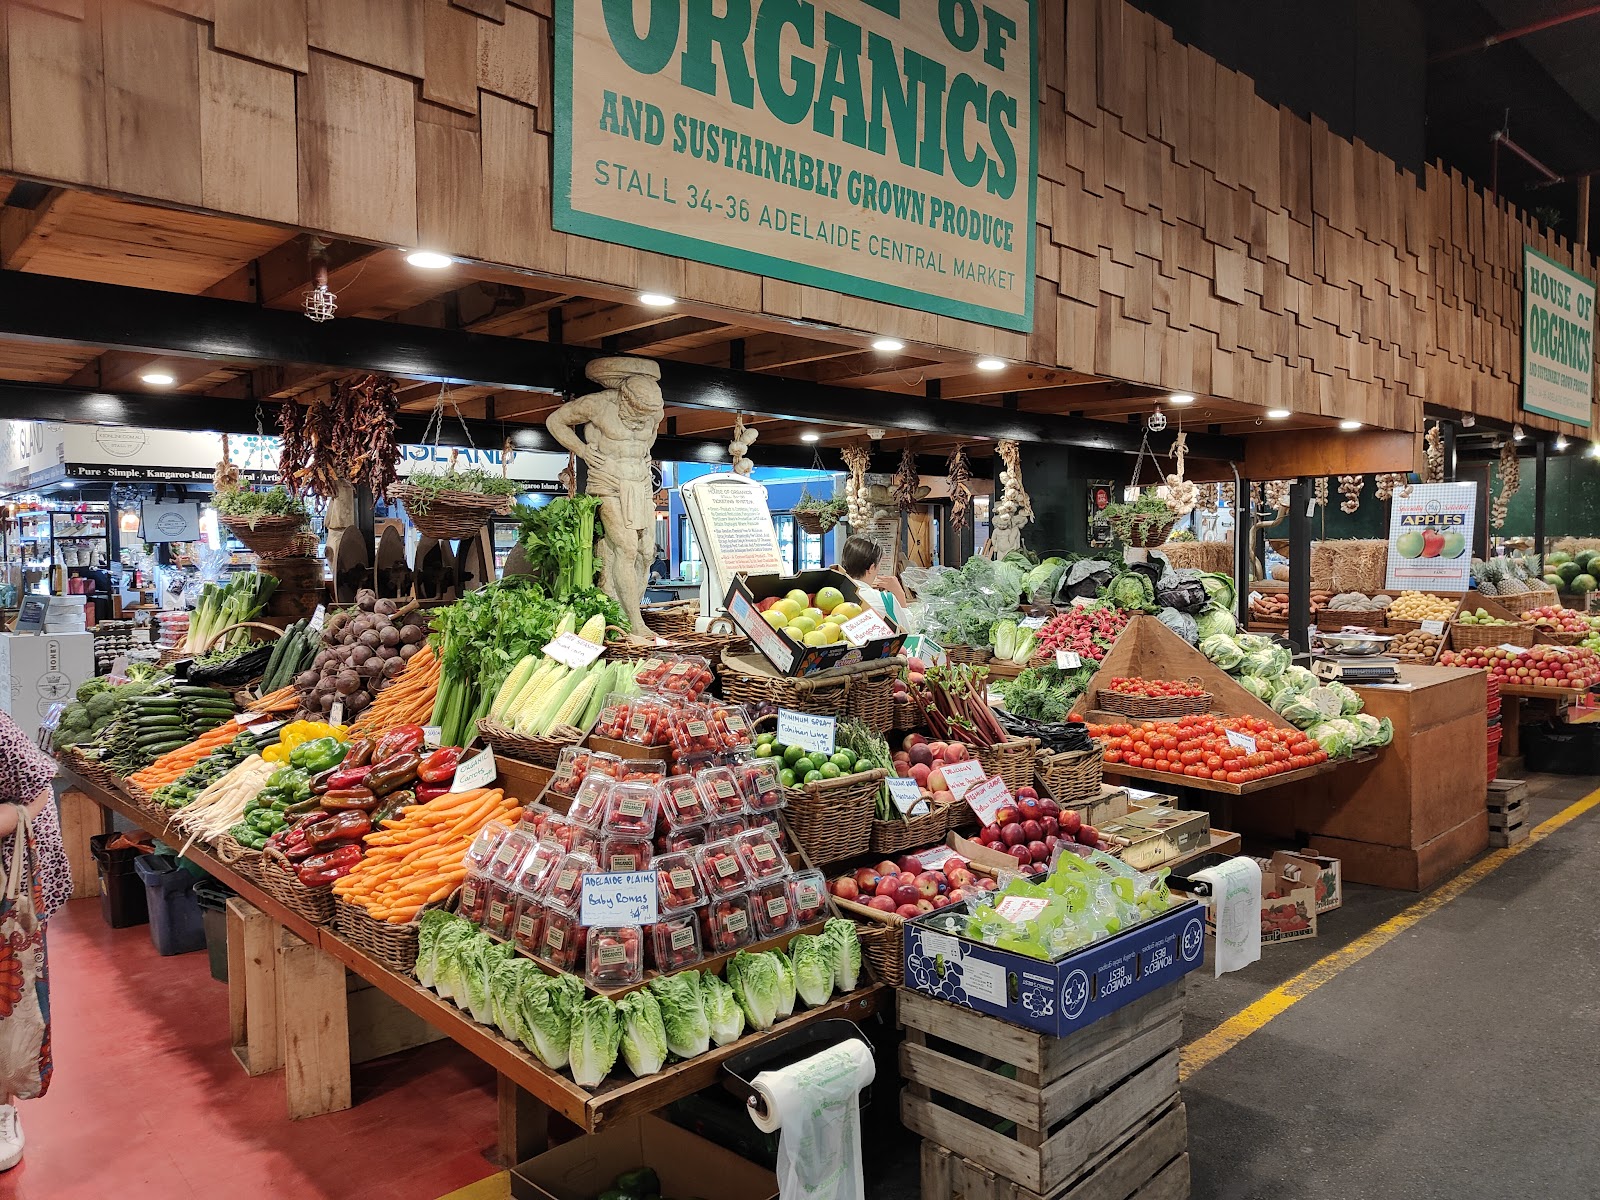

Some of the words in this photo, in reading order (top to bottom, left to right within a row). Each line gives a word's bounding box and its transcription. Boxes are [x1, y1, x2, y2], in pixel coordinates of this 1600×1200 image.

[600, 89, 665, 146] AND
[673, 112, 842, 200] SUSTAINABLY
[847, 169, 926, 226] GROWN
[928, 196, 1015, 253] PRODUCE
[594, 159, 677, 205] STALL
[686, 184, 750, 223] 34-36
[758, 205, 862, 252] ADELAIDE
[868, 234, 947, 275] CENTRAL
[953, 257, 1016, 292] MARKET
[1530, 265, 1572, 313] HOUSE
[1577, 292, 1592, 322] OF
[1529, 303, 1591, 375] ORGANICS
[78, 466, 102, 476] Pure
[146, 469, 190, 480] Kangaroo
[192, 471, 216, 480] Island
[1402, 514, 1462, 525] APPLES
[780, 711, 809, 723] MINIMUM
[810, 718, 832, 728] SPRAY
[810, 730, 828, 740] Lime
[460, 753, 488, 773] ORGANIC
[460, 768, 485, 784] Carrots
[584, 876, 623, 887] ADELAIDE
[626, 874, 655, 884] PLAINS
[588, 893, 614, 908] Baby
[616, 892, 648, 904] Romas
[1151, 946, 1167, 963] BEST
[1144, 954, 1173, 977] ROMEO'S
[1108, 966, 1126, 983] BEST
[1101, 974, 1132, 998] ROMEO'S
